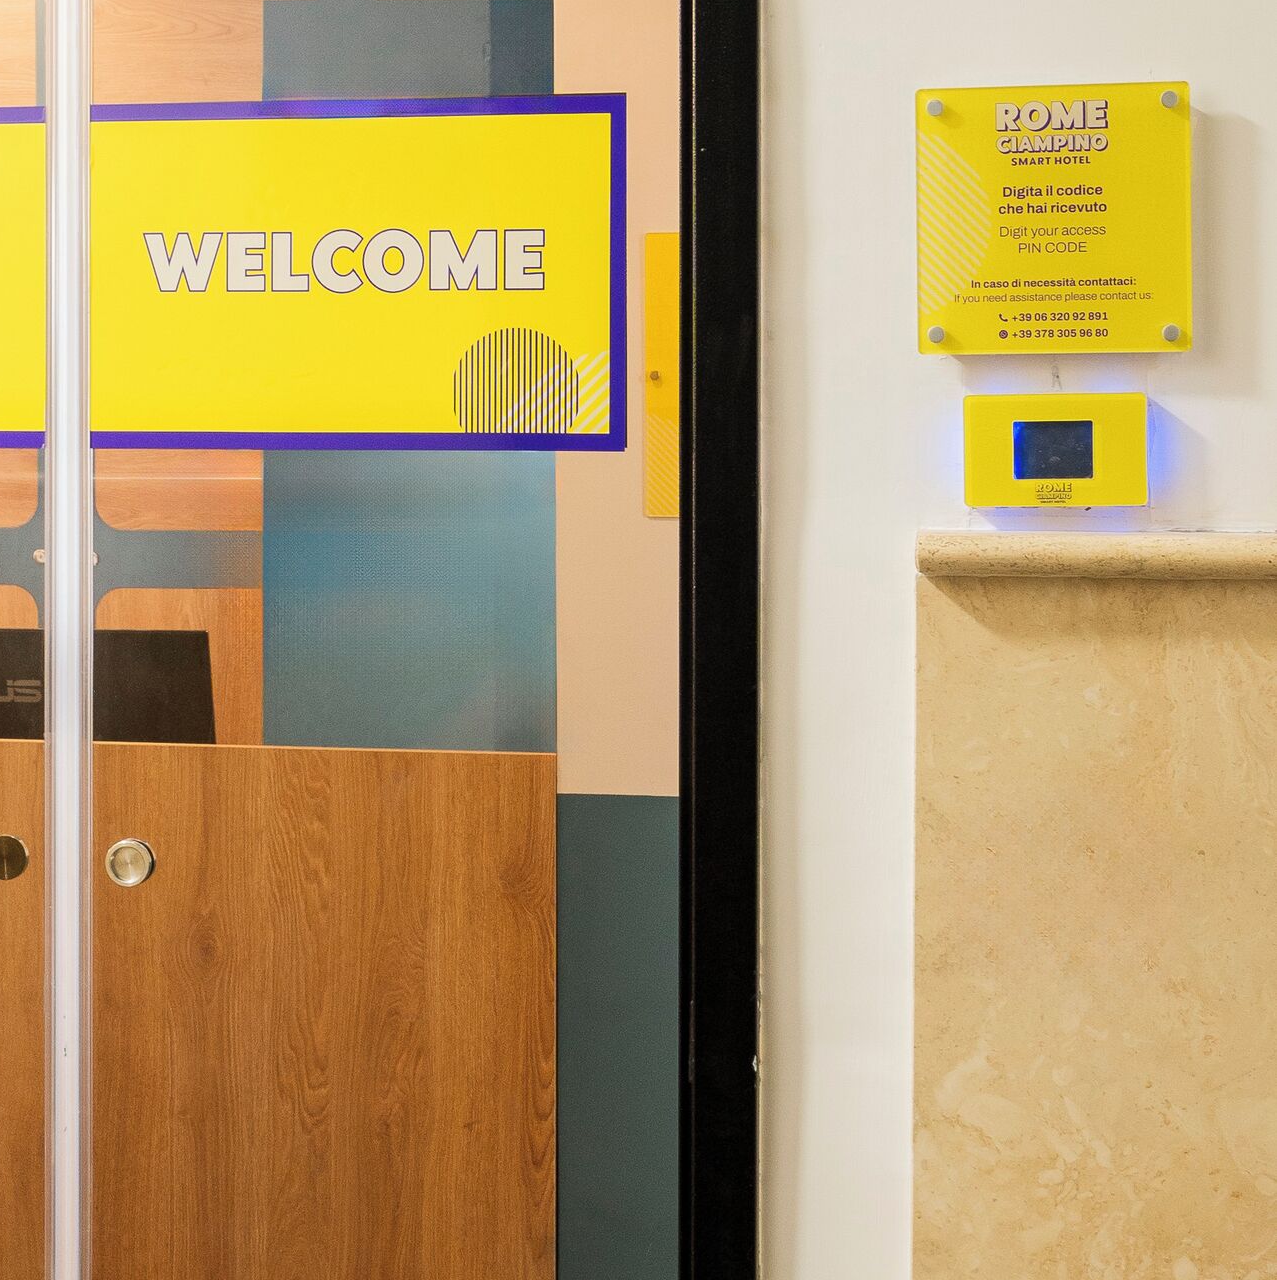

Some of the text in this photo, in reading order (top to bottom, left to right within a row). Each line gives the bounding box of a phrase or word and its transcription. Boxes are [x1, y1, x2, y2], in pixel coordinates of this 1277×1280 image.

[995, 100, 1108, 132] ROME
[996, 133, 1108, 154] CIAMPINO
[1011, 156, 1091, 166] SMART HOTEL
[1003, 184, 1103, 199] Digita il codice
[999, 201, 1107, 214] che hai ricevuto
[999, 225, 1106, 239] Digit your access
[1018, 241, 1087, 253] PIN CODE
[143, 228, 545, 293] WELCOME
[971, 276, 1137, 289] In caso di necessità contattaci:
[954, 294, 961, 303] If
[962, 294, 980, 304] you
[982, 293, 1007, 302] need
[1009, 292, 1062, 302] assistance
[1064, 291, 1097, 302] please
[1100, 290, 1137, 300] contact
[1012, 311, 1108, 322] +39 06 320 92 891
[1012, 328, 1109, 339] +39 378 305 96 80
[1035, 481, 1072, 492] ROME
